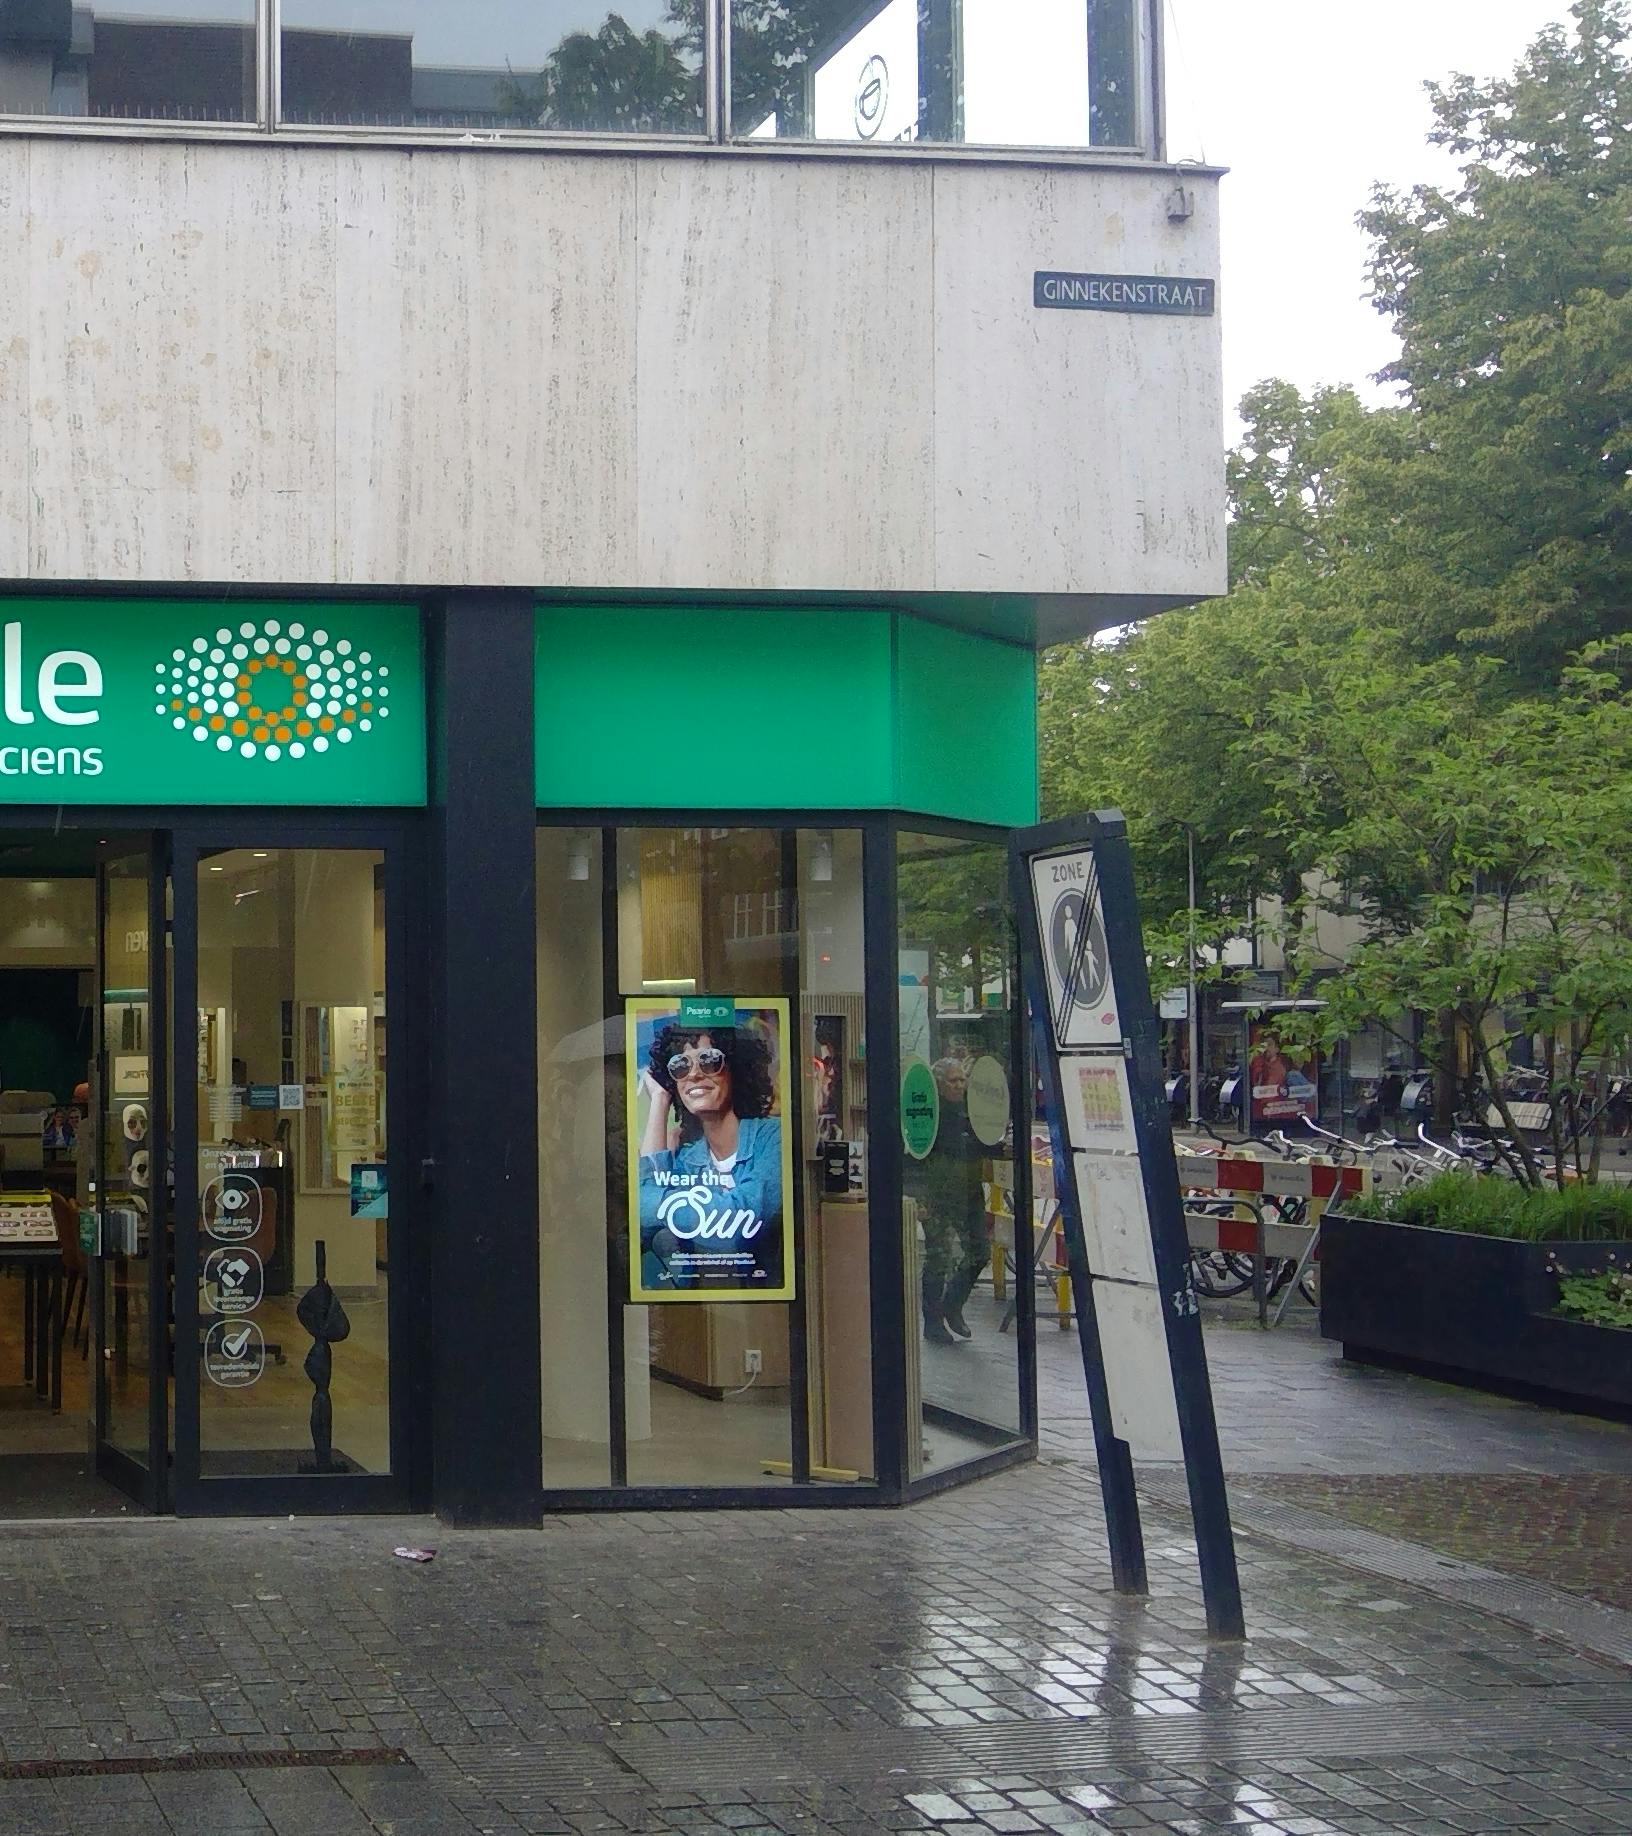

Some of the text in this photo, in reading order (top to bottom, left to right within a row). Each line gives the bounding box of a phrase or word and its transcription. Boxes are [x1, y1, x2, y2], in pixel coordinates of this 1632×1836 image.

[1043, 279, 1207, 307] GINNEKENSTRAAT
[1051, 861, 1086, 884] ZONE
[654, 1170, 730, 1186] Wear the
[657, 1185, 763, 1239] Sun
